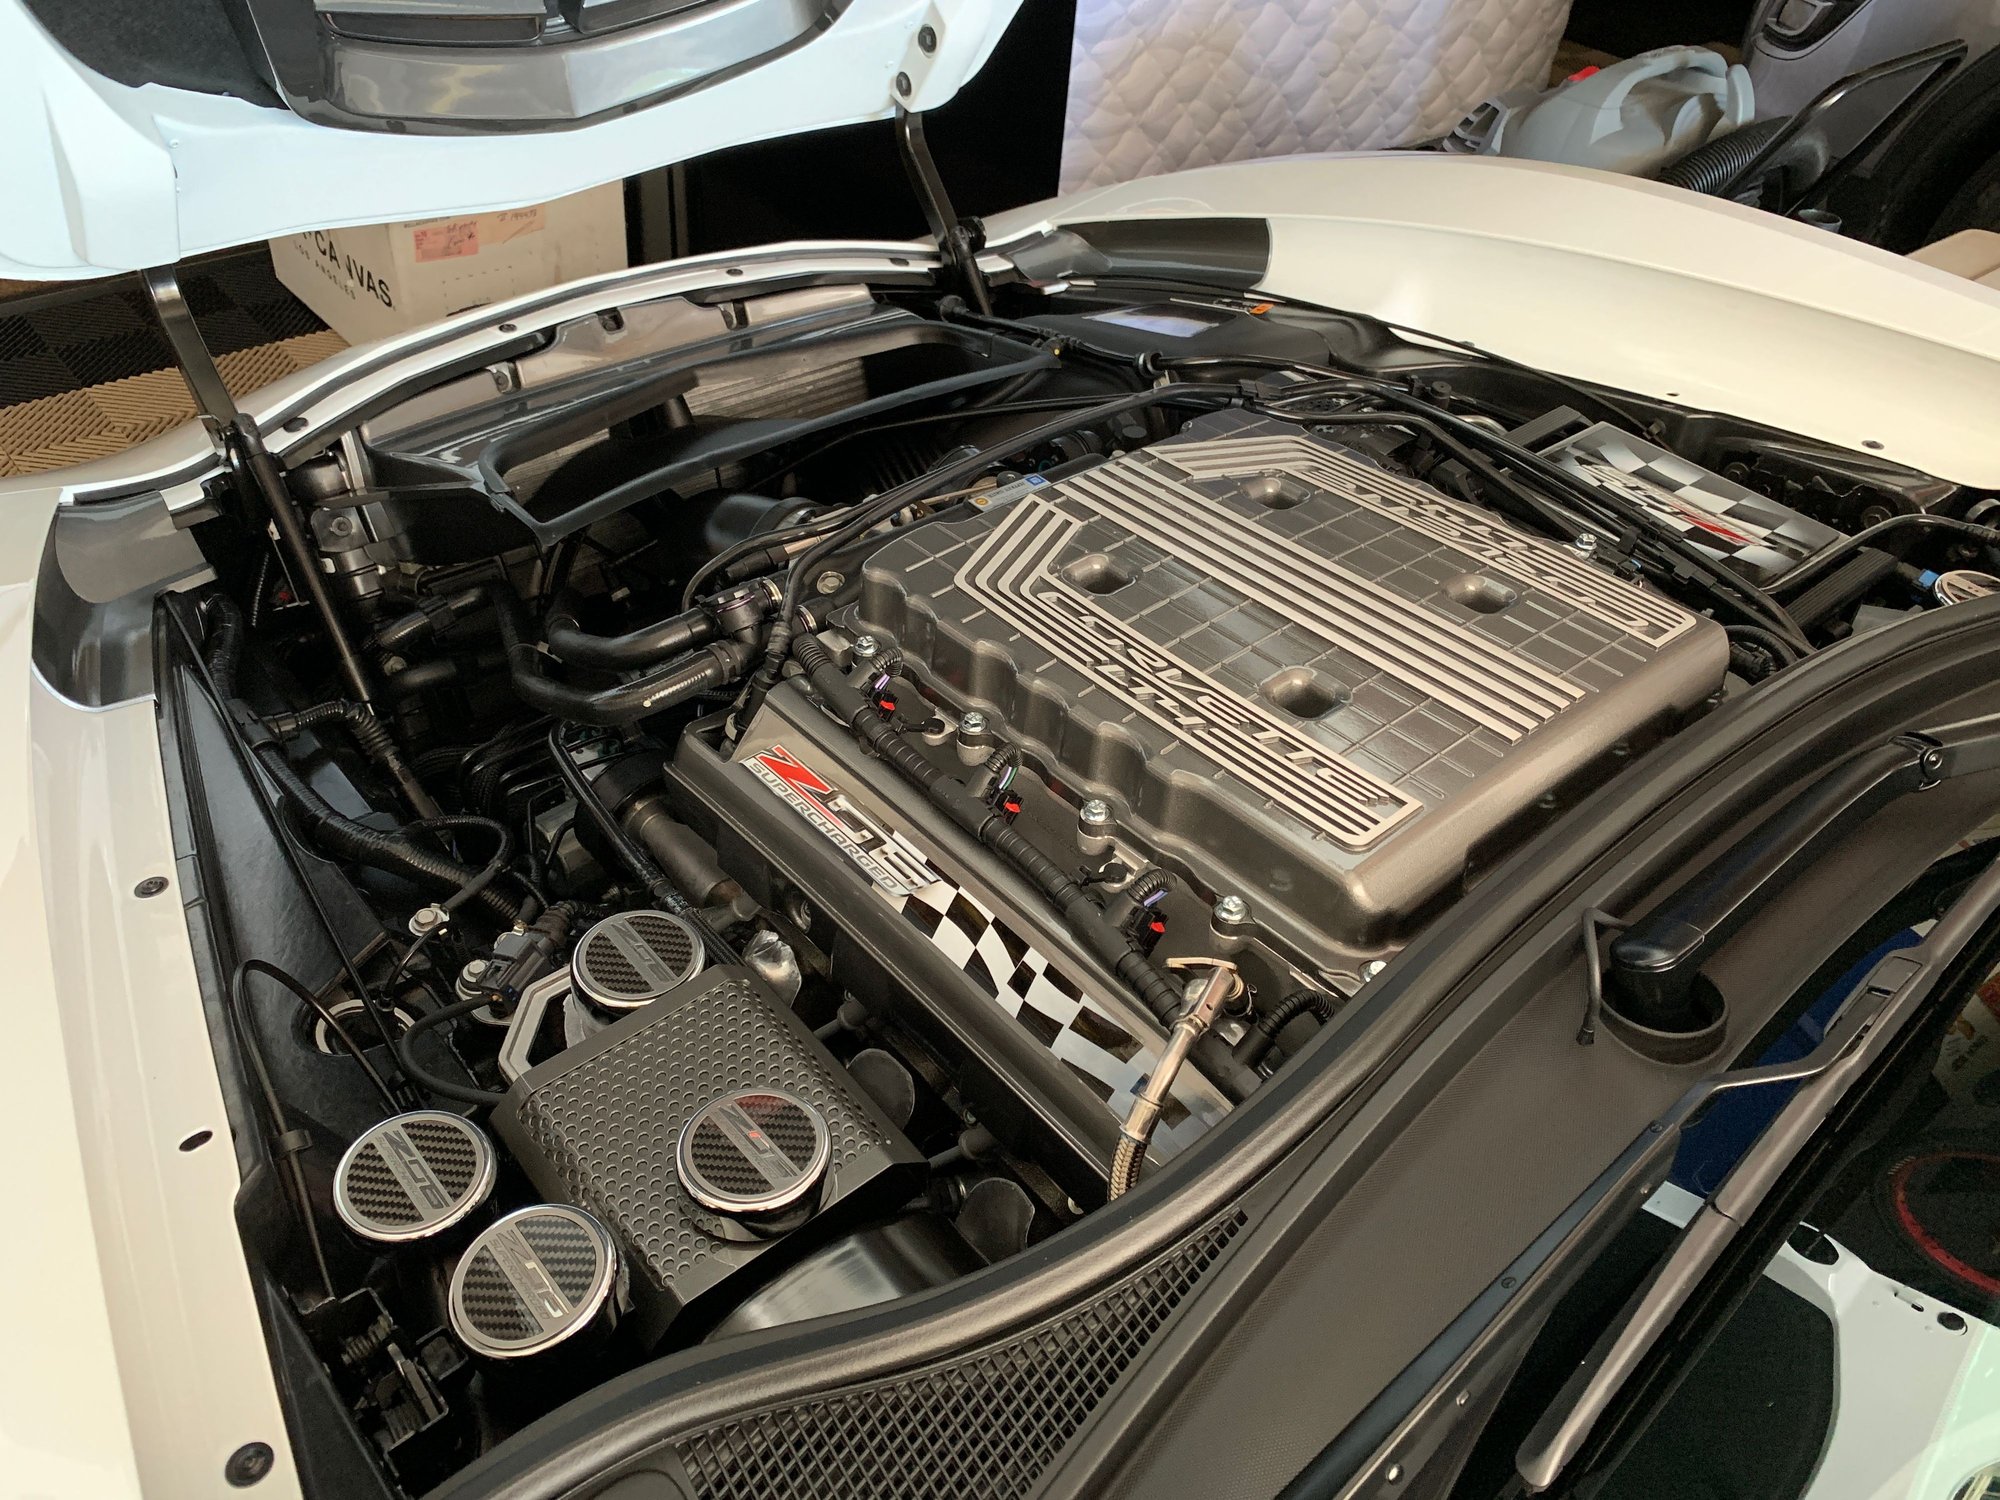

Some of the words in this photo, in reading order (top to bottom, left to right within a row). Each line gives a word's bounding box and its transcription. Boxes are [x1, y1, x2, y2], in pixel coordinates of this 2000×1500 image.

[1300, 469, 1650, 630] CORVETTE
[1414, 499, 1530, 552] LT4
[1036, 590, 1392, 805] CORVETTE
[1094, 663, 1209, 730] LT4
[749, 761, 900, 891] SUPERCHARGED
[756, 744, 942, 892] Z06
[381, 1129, 451, 1210] Z06
[488, 1238, 551, 1320] SUPERCHARGED
[495, 1228, 569, 1318] Z06
